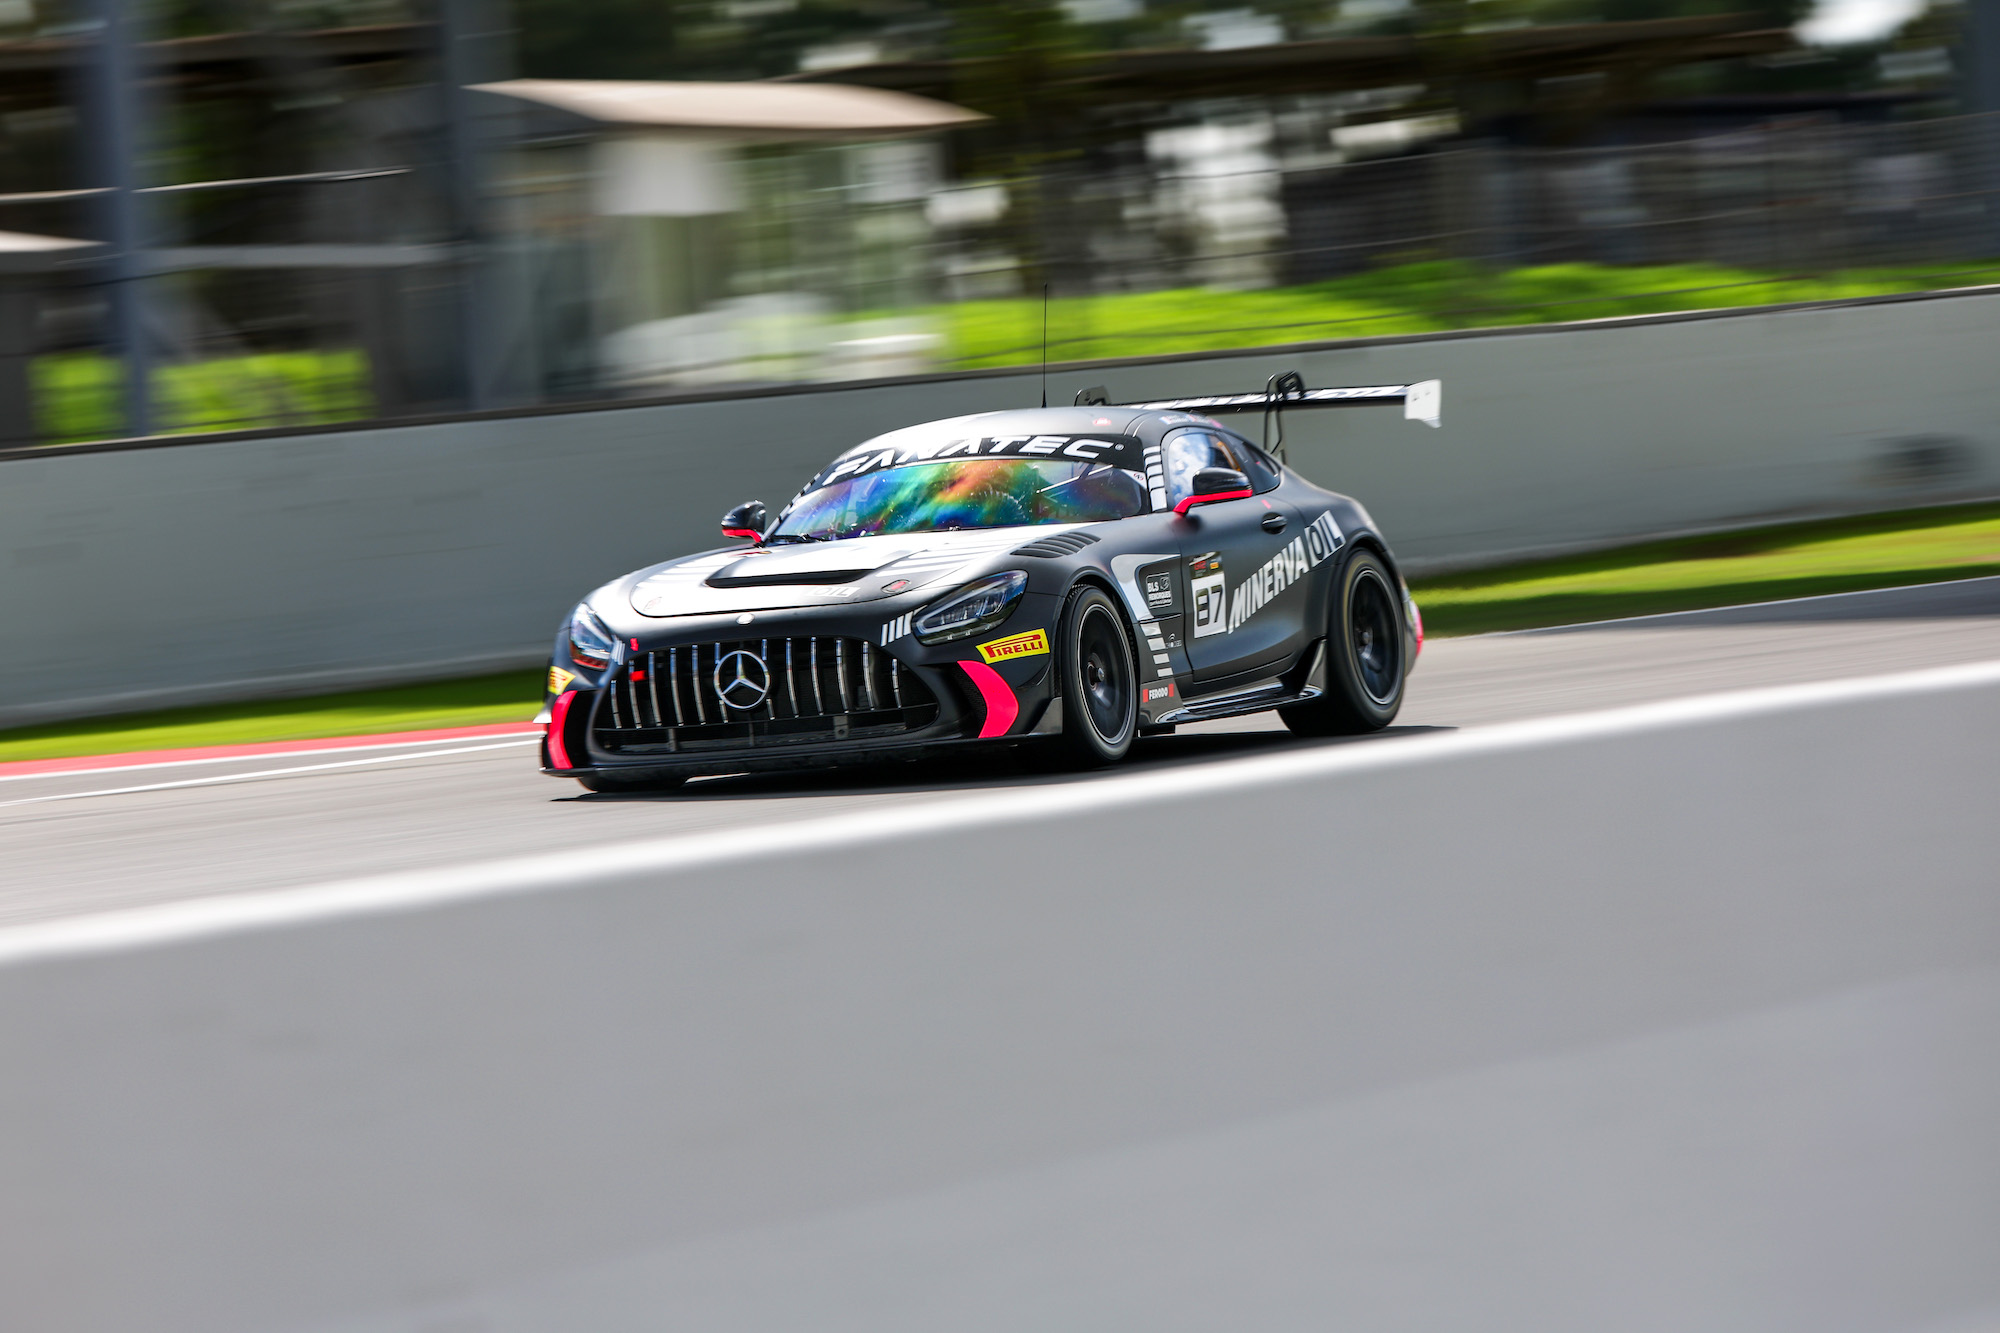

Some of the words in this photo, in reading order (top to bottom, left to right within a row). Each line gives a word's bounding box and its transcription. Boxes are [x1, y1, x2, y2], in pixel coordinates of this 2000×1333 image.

[822, 435, 1114, 486] FANATEC
[1228, 535, 1310, 634] MINERVA
[1306, 512, 1345, 563] OIL
[1195, 584, 1223, 628] 87
[984, 634, 1043, 658] PIRELLI
